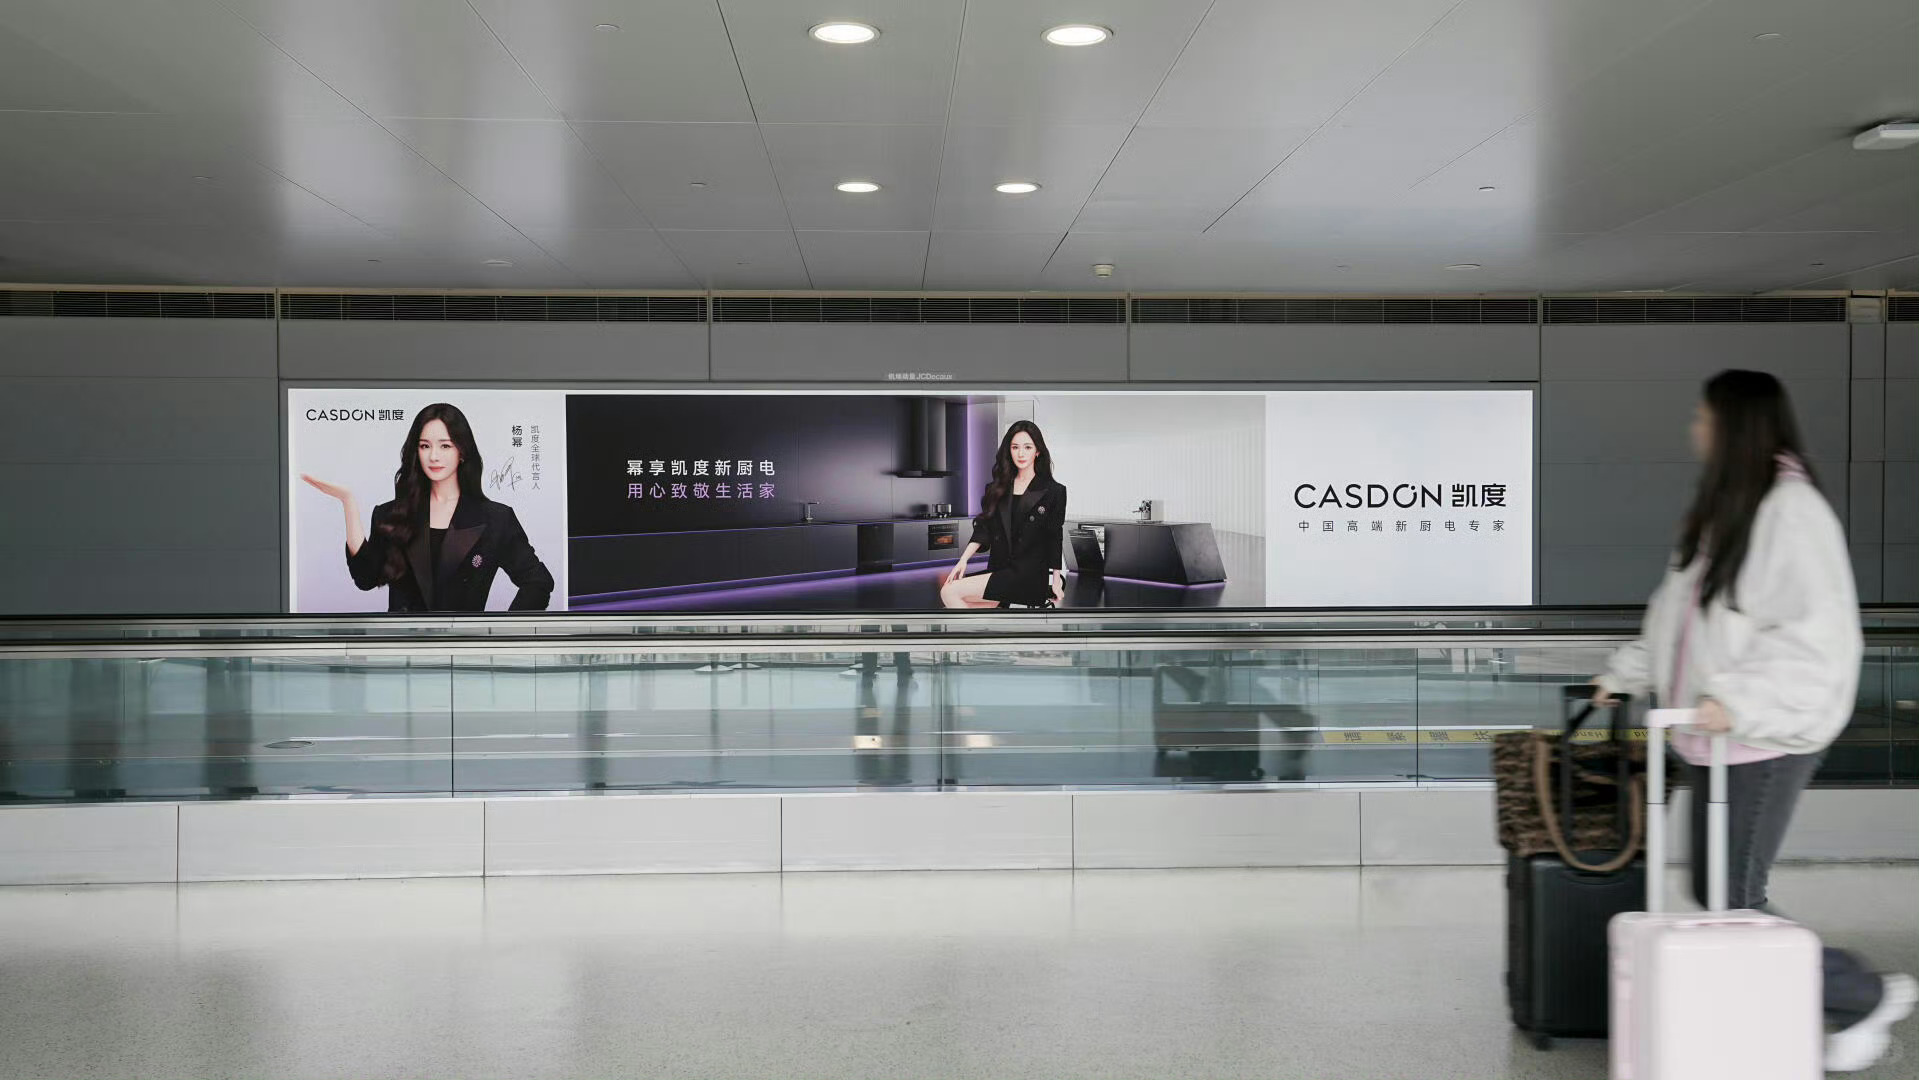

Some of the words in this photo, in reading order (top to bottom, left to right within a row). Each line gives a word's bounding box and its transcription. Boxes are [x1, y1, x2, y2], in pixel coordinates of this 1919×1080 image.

[305, 408, 375, 421] CASDON
[378, 409, 404, 421] 凯度
[511, 425, 523, 448] 杨幂
[530, 425, 541, 490] 凯度全球代言人
[626, 459, 776, 476] 幂享凯度新厨电
[627, 482, 776, 499] 用心致敬生活家
[1294, 483, 1442, 509] CASDON
[1451, 483, 1507, 508] 凯度
[1298, 519, 1506, 532] 中国高端新厨电专家
